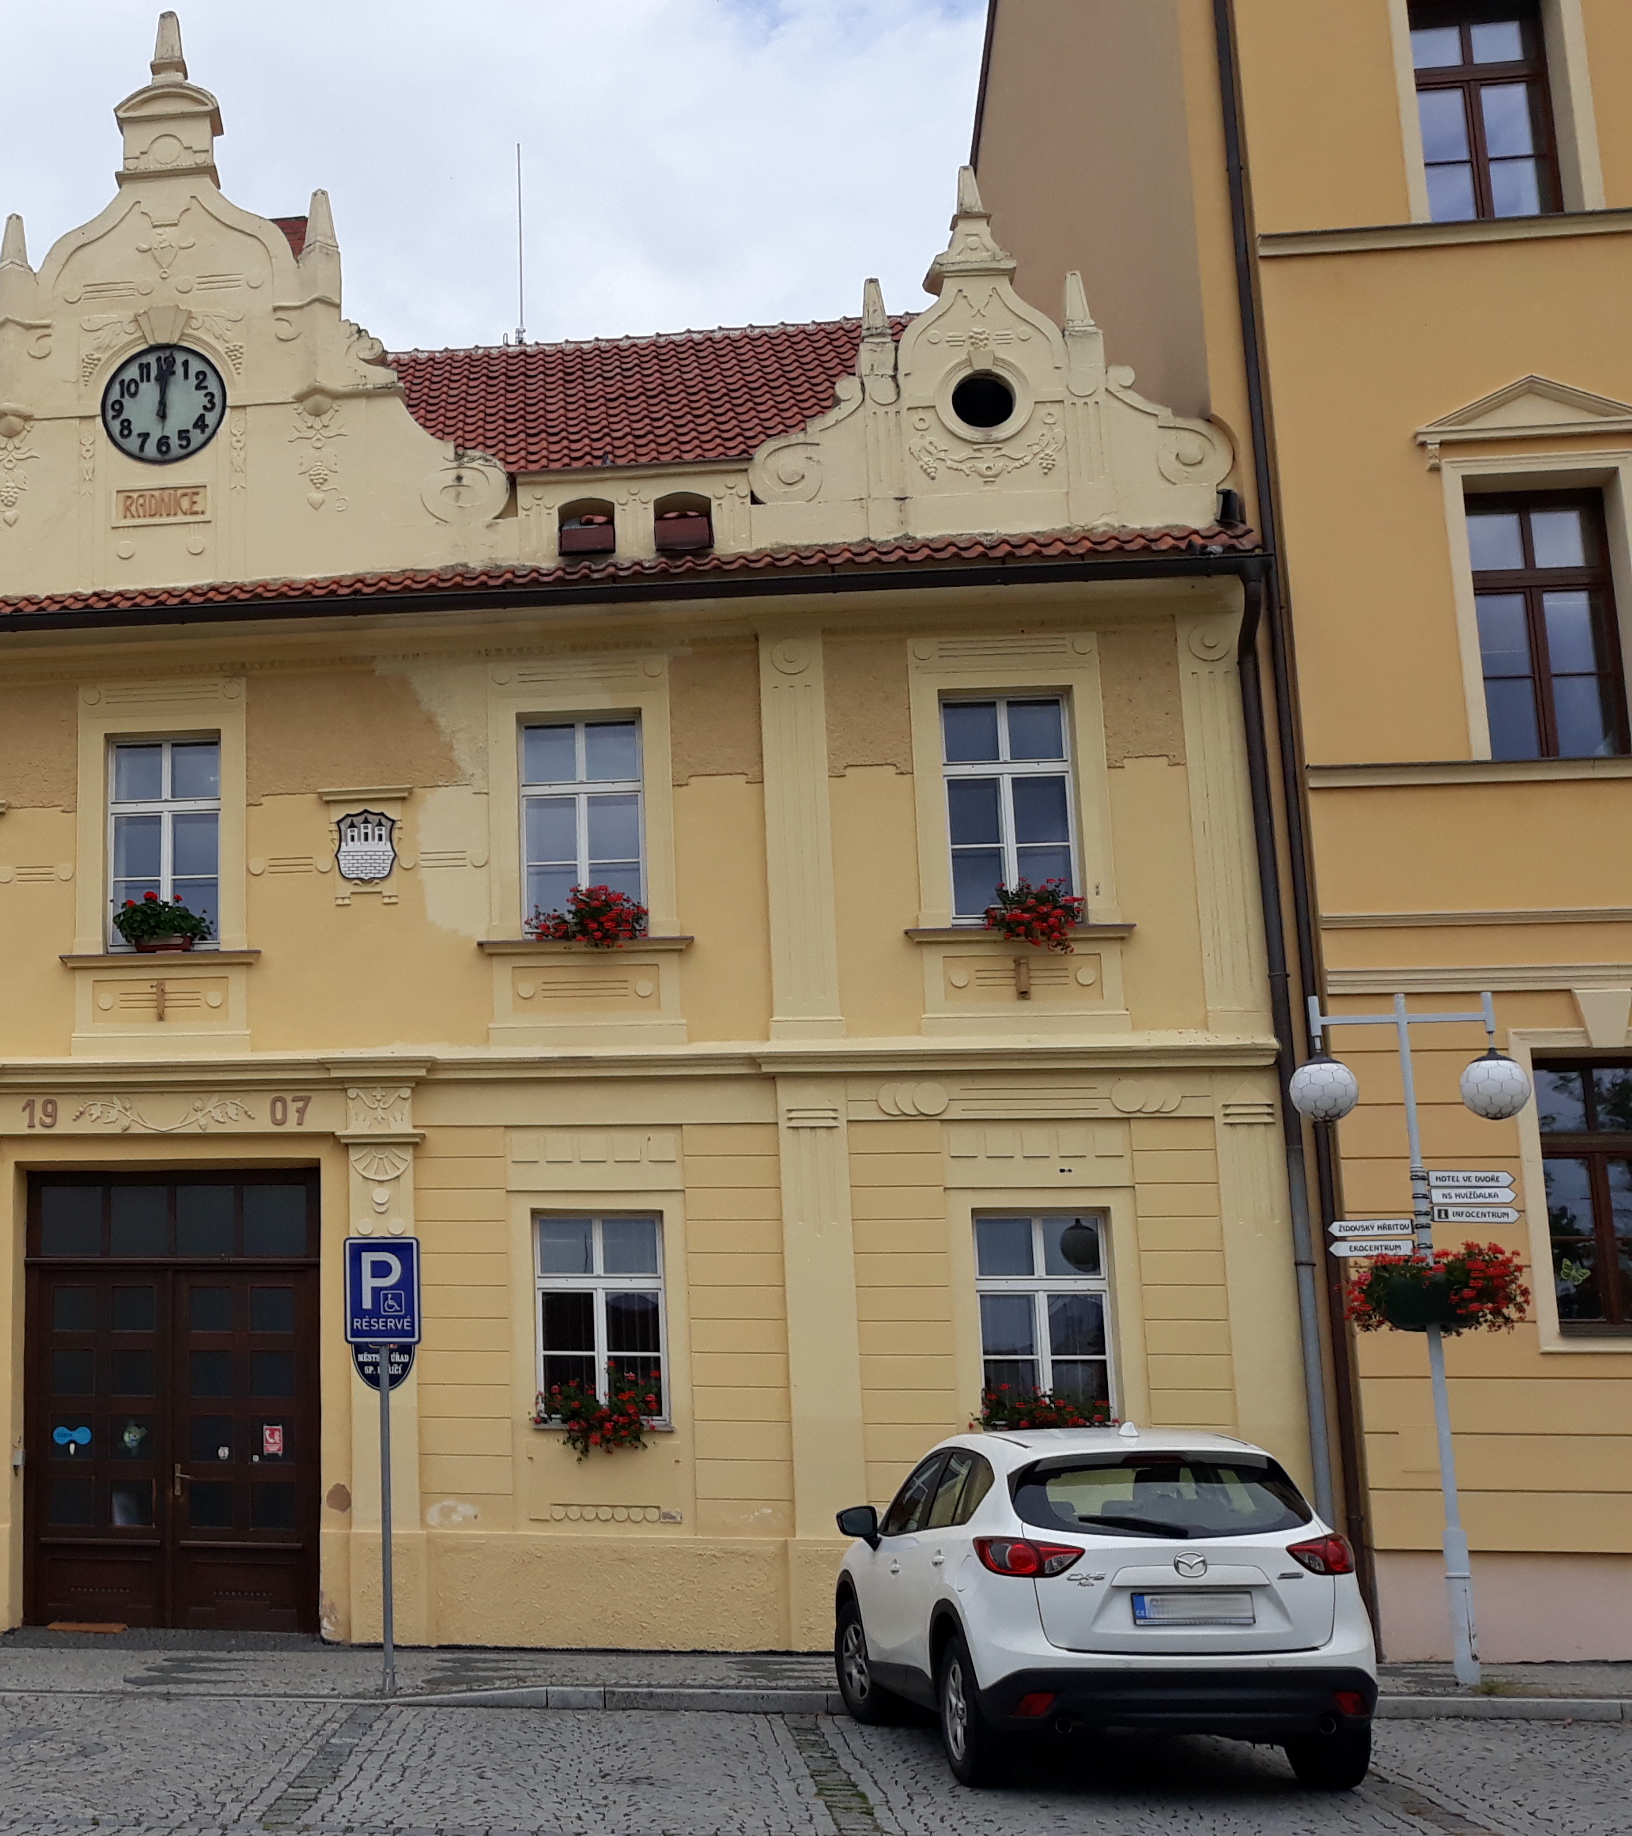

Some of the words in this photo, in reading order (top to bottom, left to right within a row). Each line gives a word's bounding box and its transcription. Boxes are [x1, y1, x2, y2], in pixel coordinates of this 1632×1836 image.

[138, 362, 151, 382] 11
[181, 359, 189, 380] 1
[118, 378, 140, 399] 10
[194, 370, 208, 391] 2
[110, 399, 124, 420] 9
[202, 391, 216, 412] 3
[118, 418, 132, 439] 8
[192, 413, 209, 434] 4
[136, 432, 150, 453] 7
[156, 435, 171, 456] 6
[177, 429, 191, 449] 5
[21, 1098, 58, 1128] 19
[269, 1095, 312, 1126] 07
[1435, 1175, 1460, 1183] HOTEL
[1462, 1175, 1473, 1183] VE
[1474, 1174, 1501, 1183] DVOŘE
[1452, 1210, 1510, 1219] INFOCENTRUM
[1376, 1222, 1410, 1231] HŘBITOV
[1349, 1244, 1402, 1252] EKOCENTRUM
[361, 1252, 402, 1310] P
[353, 1315, 412, 1330] RÉSERVÉ
[357, 1351, 385, 1362] MĚSTS
[390, 1351, 410, 1362] ÚŘAD
